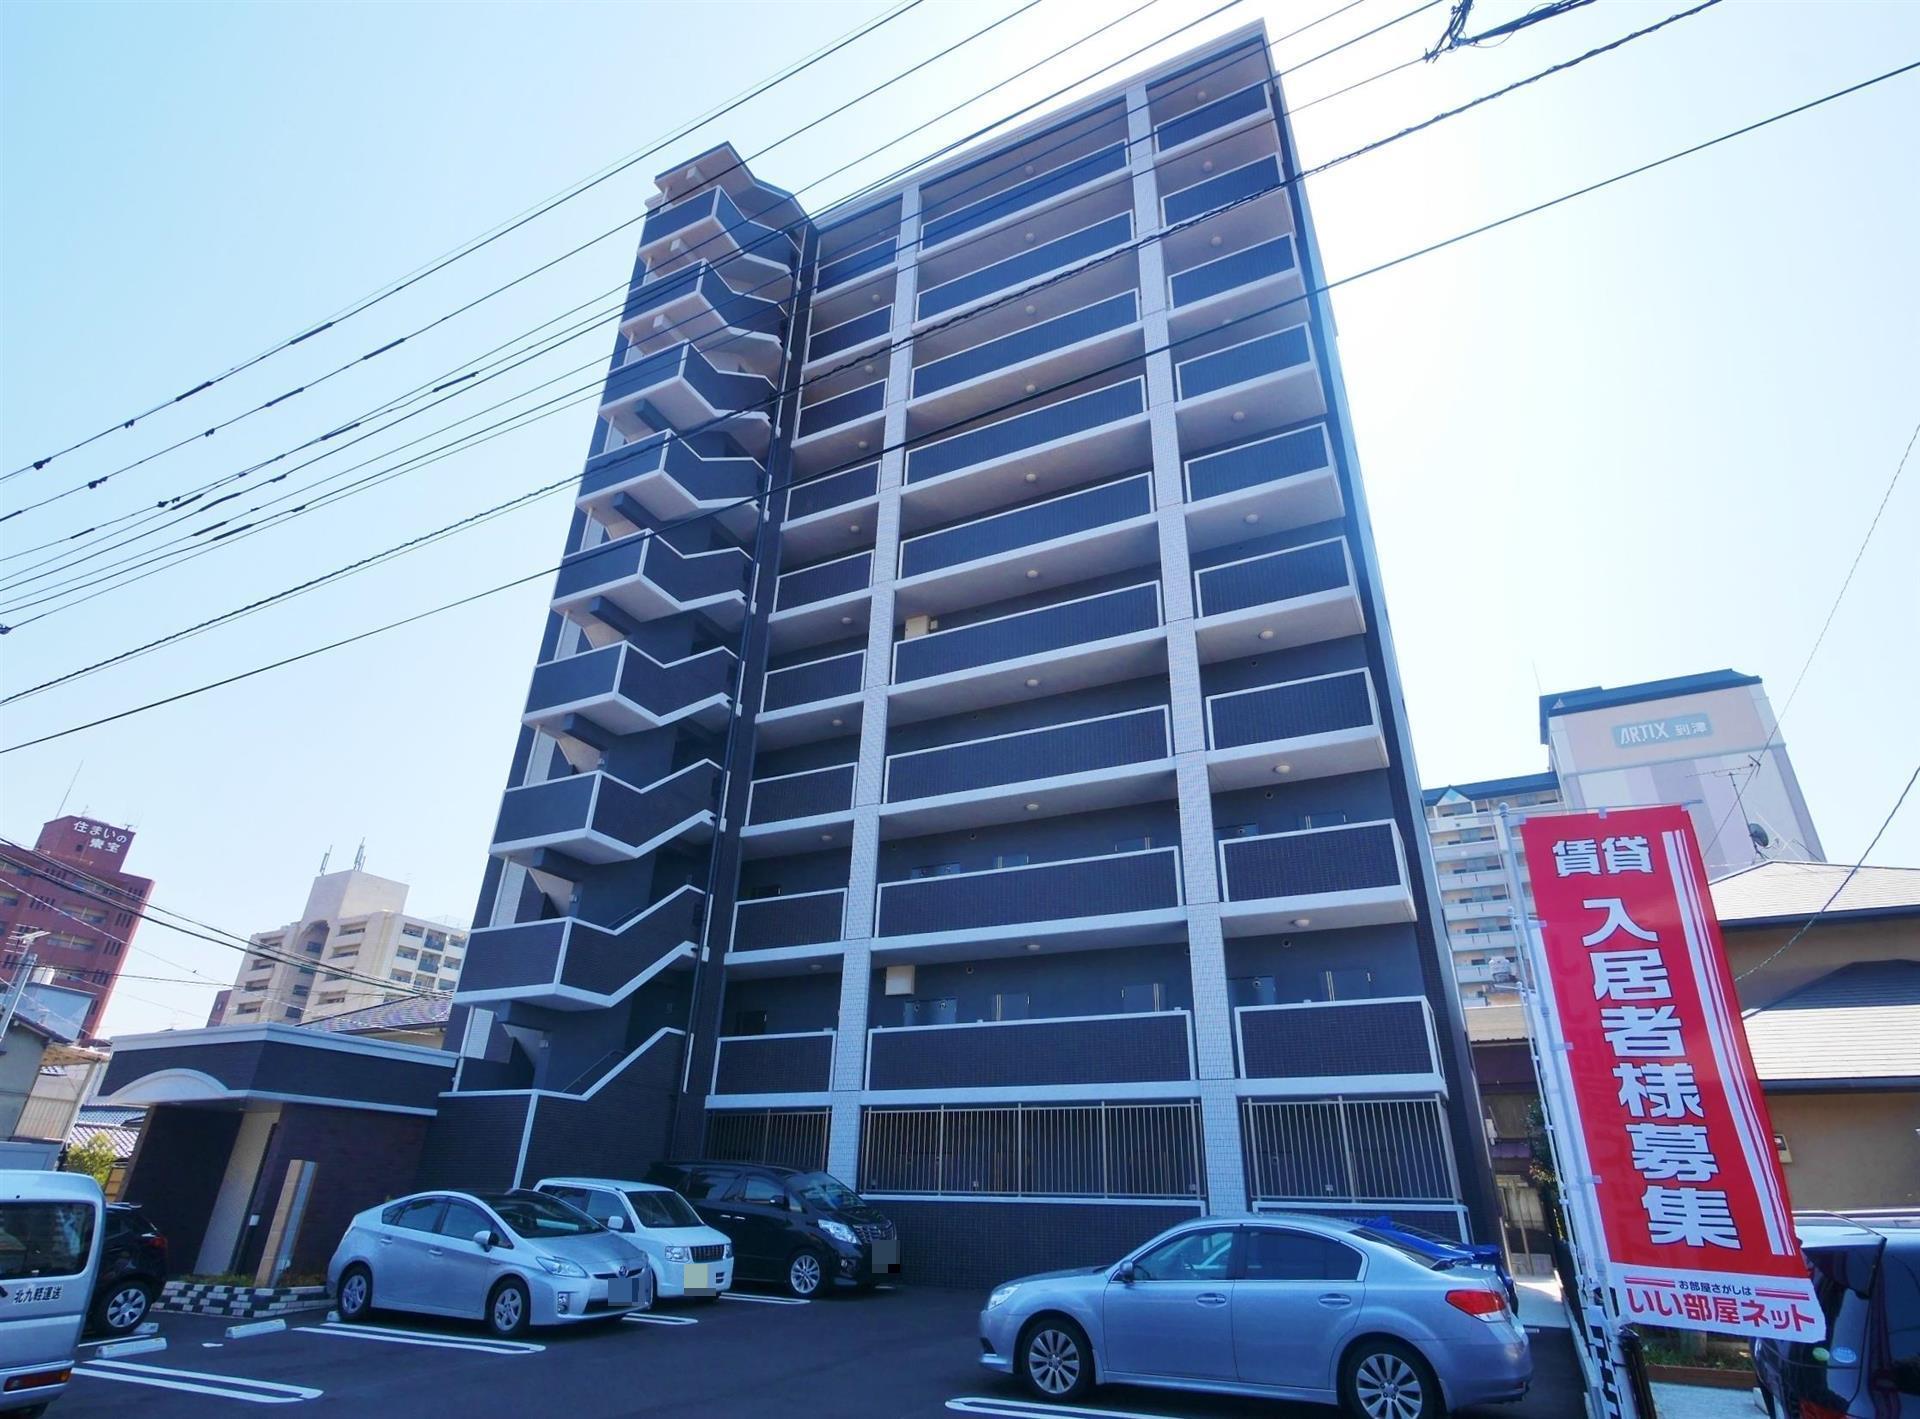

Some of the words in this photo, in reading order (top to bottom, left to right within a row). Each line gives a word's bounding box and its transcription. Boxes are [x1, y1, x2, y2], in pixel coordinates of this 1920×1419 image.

[1620, 721, 1670, 745] ARTIX
[73, 820, 127, 843] 住まいの
[1551, 836, 1655, 877] 賃貸
[1582, 897, 1742, 1250] 入居者様募集
[1678, 1280, 1752, 1296] お部屋さがしは
[1626, 1287, 1816, 1333] いい部屋ネット
